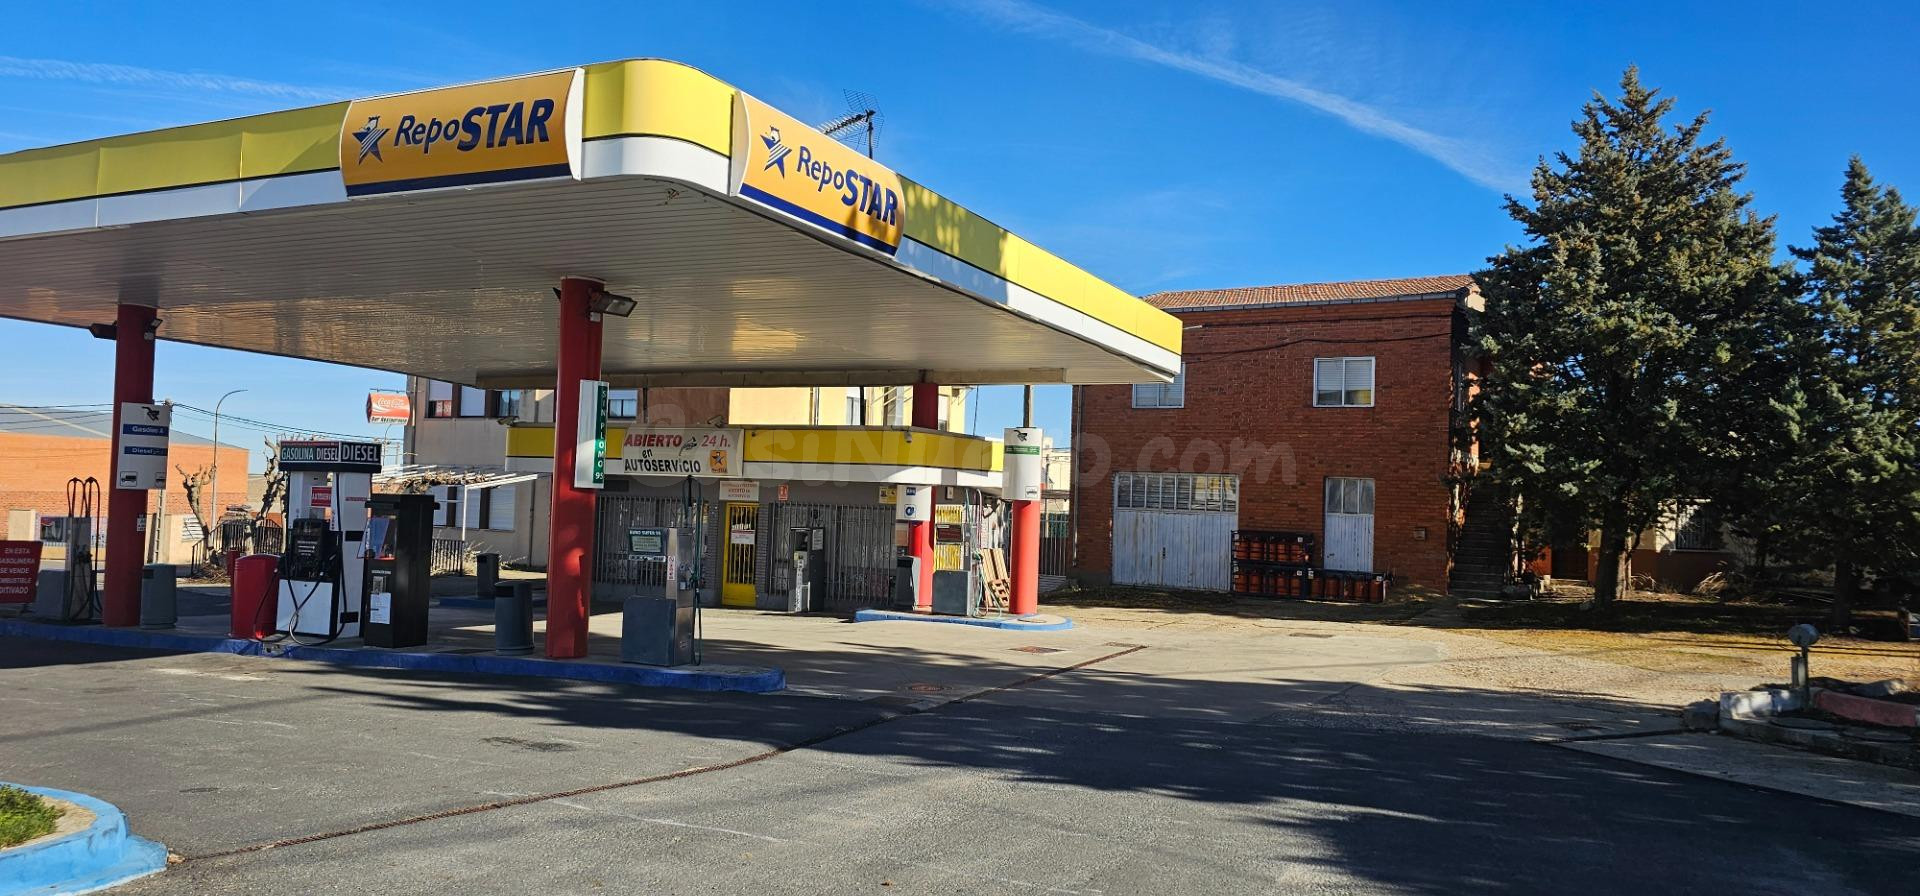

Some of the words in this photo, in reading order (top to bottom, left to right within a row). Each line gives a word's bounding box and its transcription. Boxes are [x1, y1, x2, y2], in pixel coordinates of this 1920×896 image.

[393, 99, 554, 154] RepoSTAR
[797, 145, 898, 226] RepoSTAR
[624, 434, 683, 447] ABIERTO
[701, 434, 717, 448] 24
[717, 434, 731, 448] h.
[281, 447, 314, 461] GASOLINA
[316, 447, 338, 461] DIESEL
[342, 445, 379, 462] DIESEL
[642, 447, 653, 459] en
